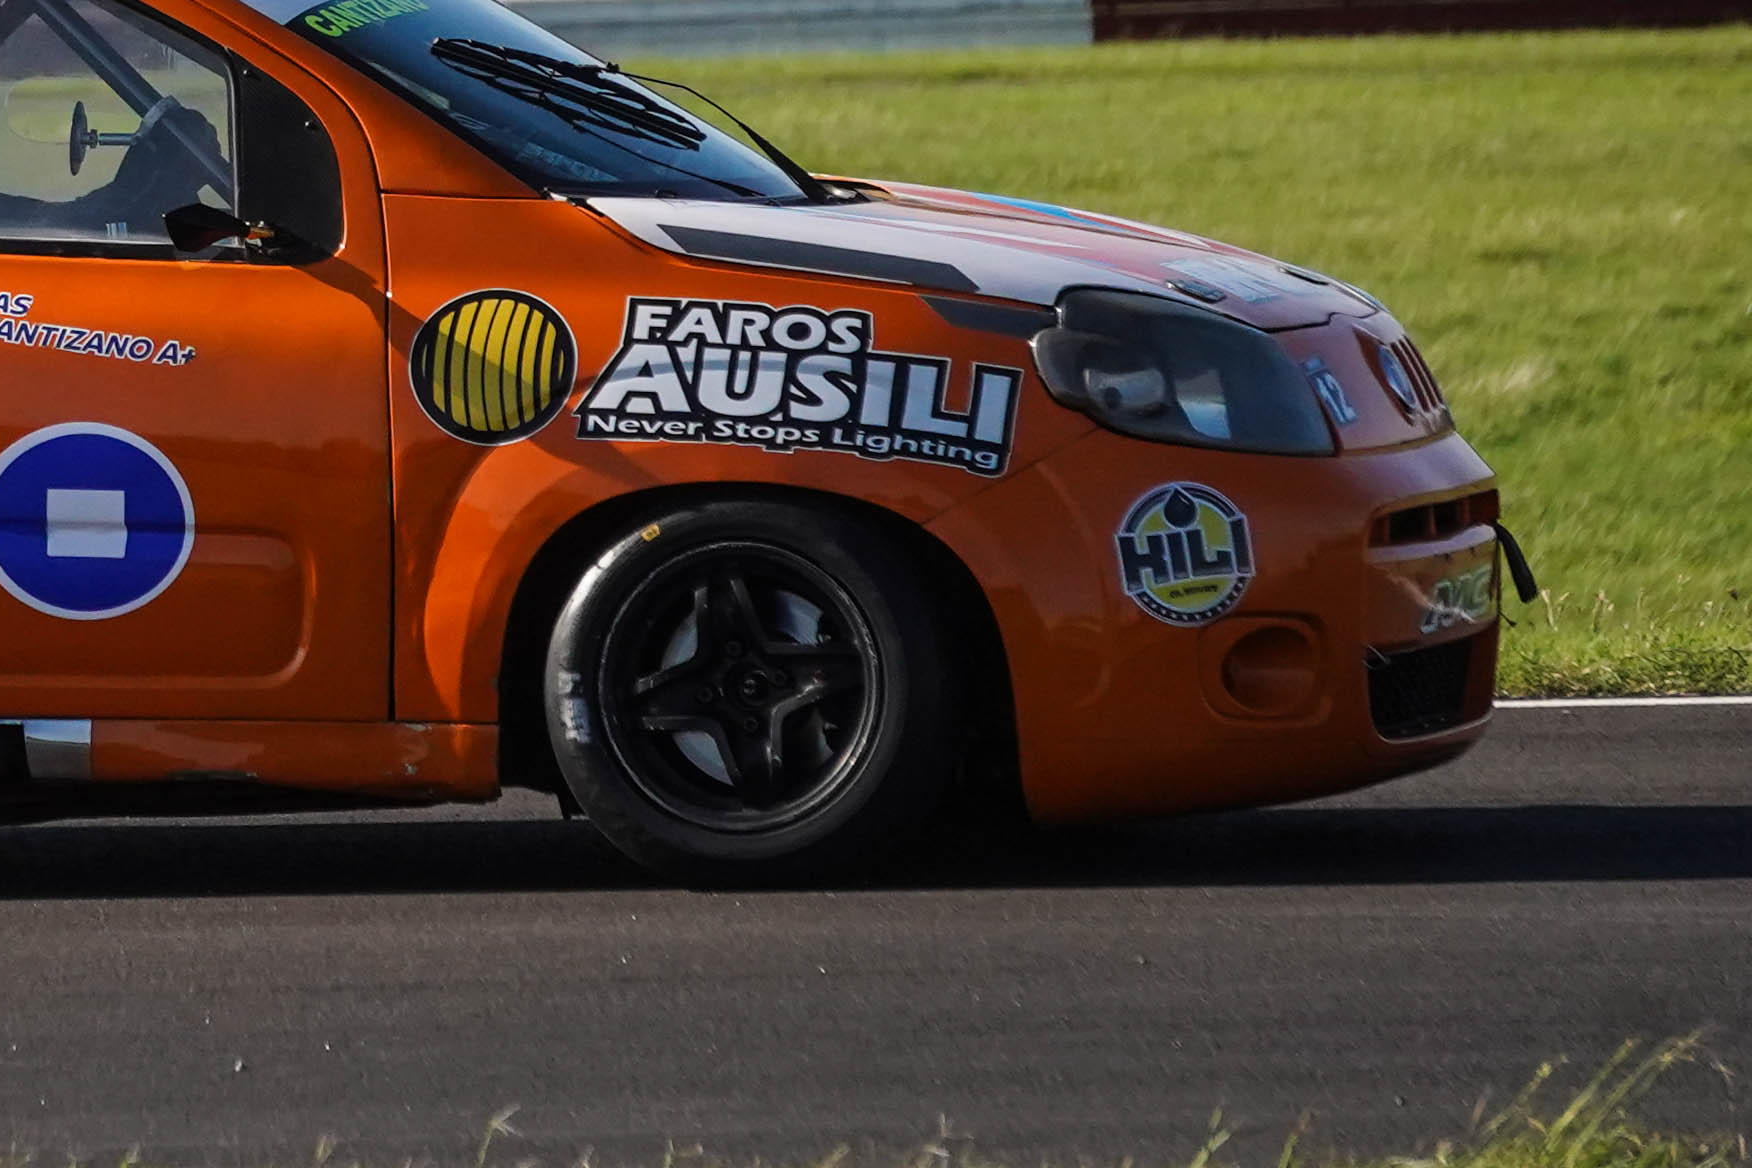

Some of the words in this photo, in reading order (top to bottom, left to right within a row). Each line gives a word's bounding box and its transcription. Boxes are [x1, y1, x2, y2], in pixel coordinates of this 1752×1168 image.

[632, 304, 864, 354] FAROS
[588, 343, 1014, 445] AUSILI
[586, 413, 703, 436] Never
[713, 418, 821, 446] Stops
[831, 428, 1000, 471] Lighting
[1116, 515, 1255, 595] HILI
